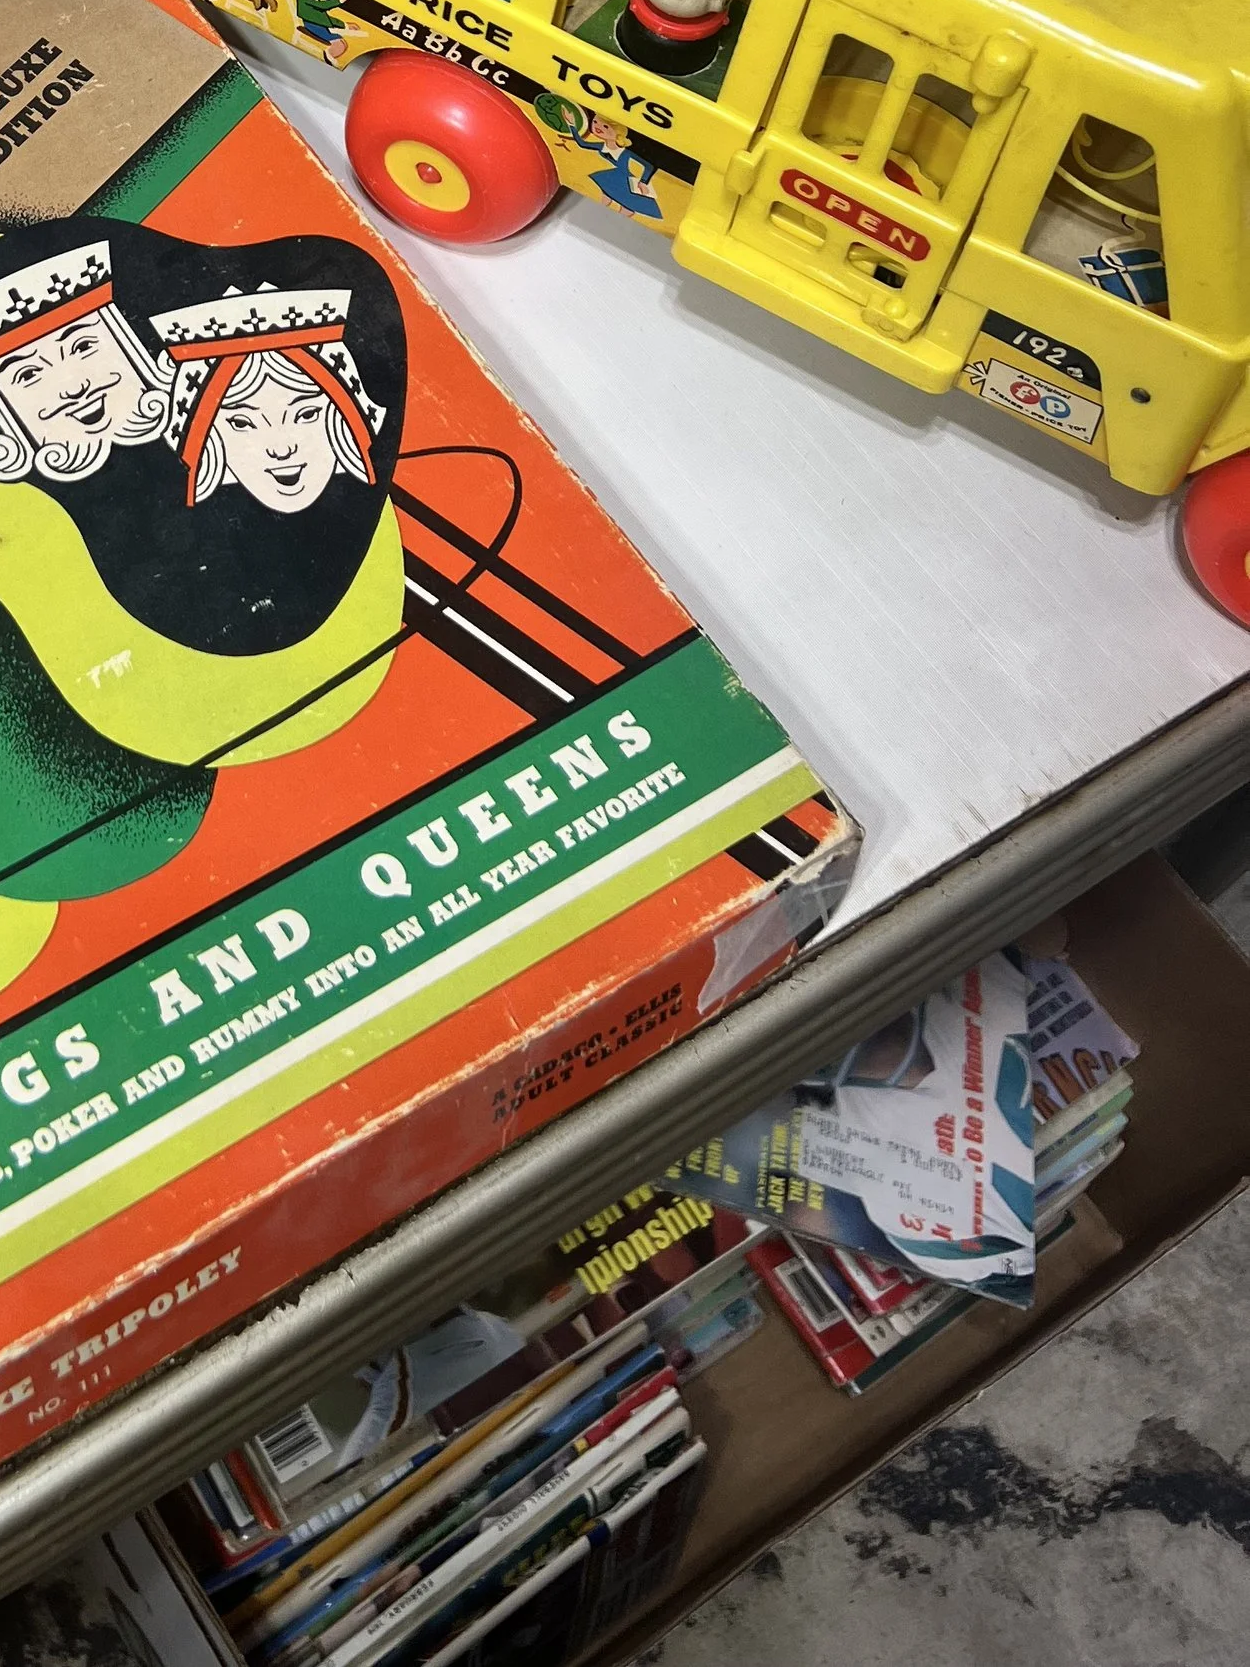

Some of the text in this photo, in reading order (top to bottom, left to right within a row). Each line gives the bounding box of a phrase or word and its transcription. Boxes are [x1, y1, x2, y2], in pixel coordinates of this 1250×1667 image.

[551, 56, 676, 129] TOYS
[792, 177, 919, 254] OPEN
[1012, 330, 1068, 365] 192
[148, 907, 313, 1026] AND
[358, 709, 654, 899] QUEENS
[10, 1091, 121, 1168] POKER
[121, 1053, 188, 1107] AND
[188, 985, 302, 1066] RUMMY
[303, 942, 379, 999] INTO
[380, 917, 425, 954] AN
[426, 884, 484, 928] ALL
[479, 838, 560, 894] YEAR
[553, 761, 687, 851] FAVORITE
[491, 998, 682, 1125] ADULT CLASSIC
[513, 1031, 603, 1092] CADACO
[624, 982, 682, 1027] ELLIS
[768, 1175, 786, 1214] JACK
[50, 1244, 244, 1379] TRIPOLEY
[26, 1396, 66, 1425] NO.
